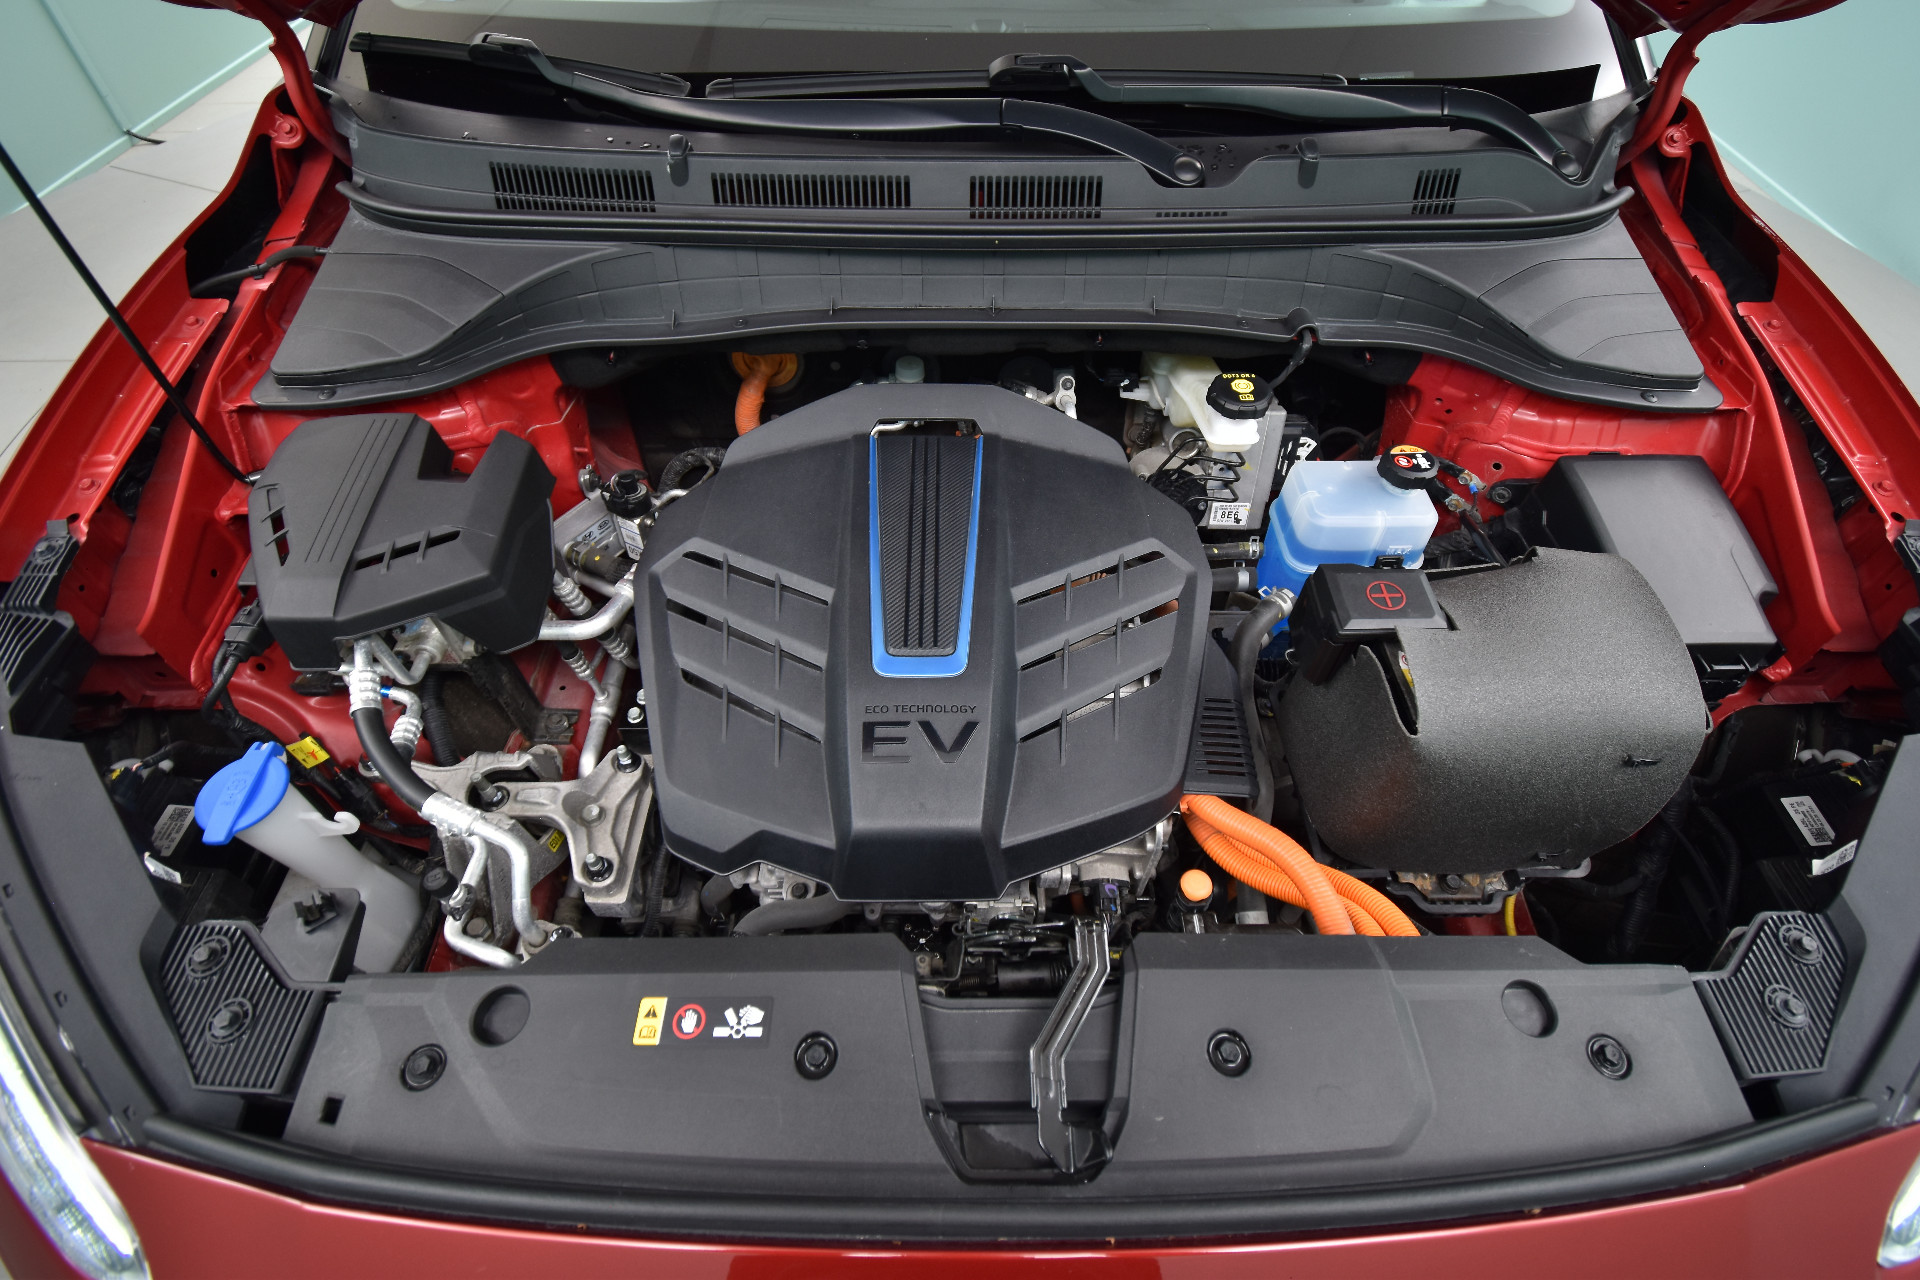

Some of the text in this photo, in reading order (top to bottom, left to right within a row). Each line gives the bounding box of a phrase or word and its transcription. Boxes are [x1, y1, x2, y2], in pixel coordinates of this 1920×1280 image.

[865, 704, 977, 714] ECO TECHNOLOGY
[861, 720, 980, 763] EV
